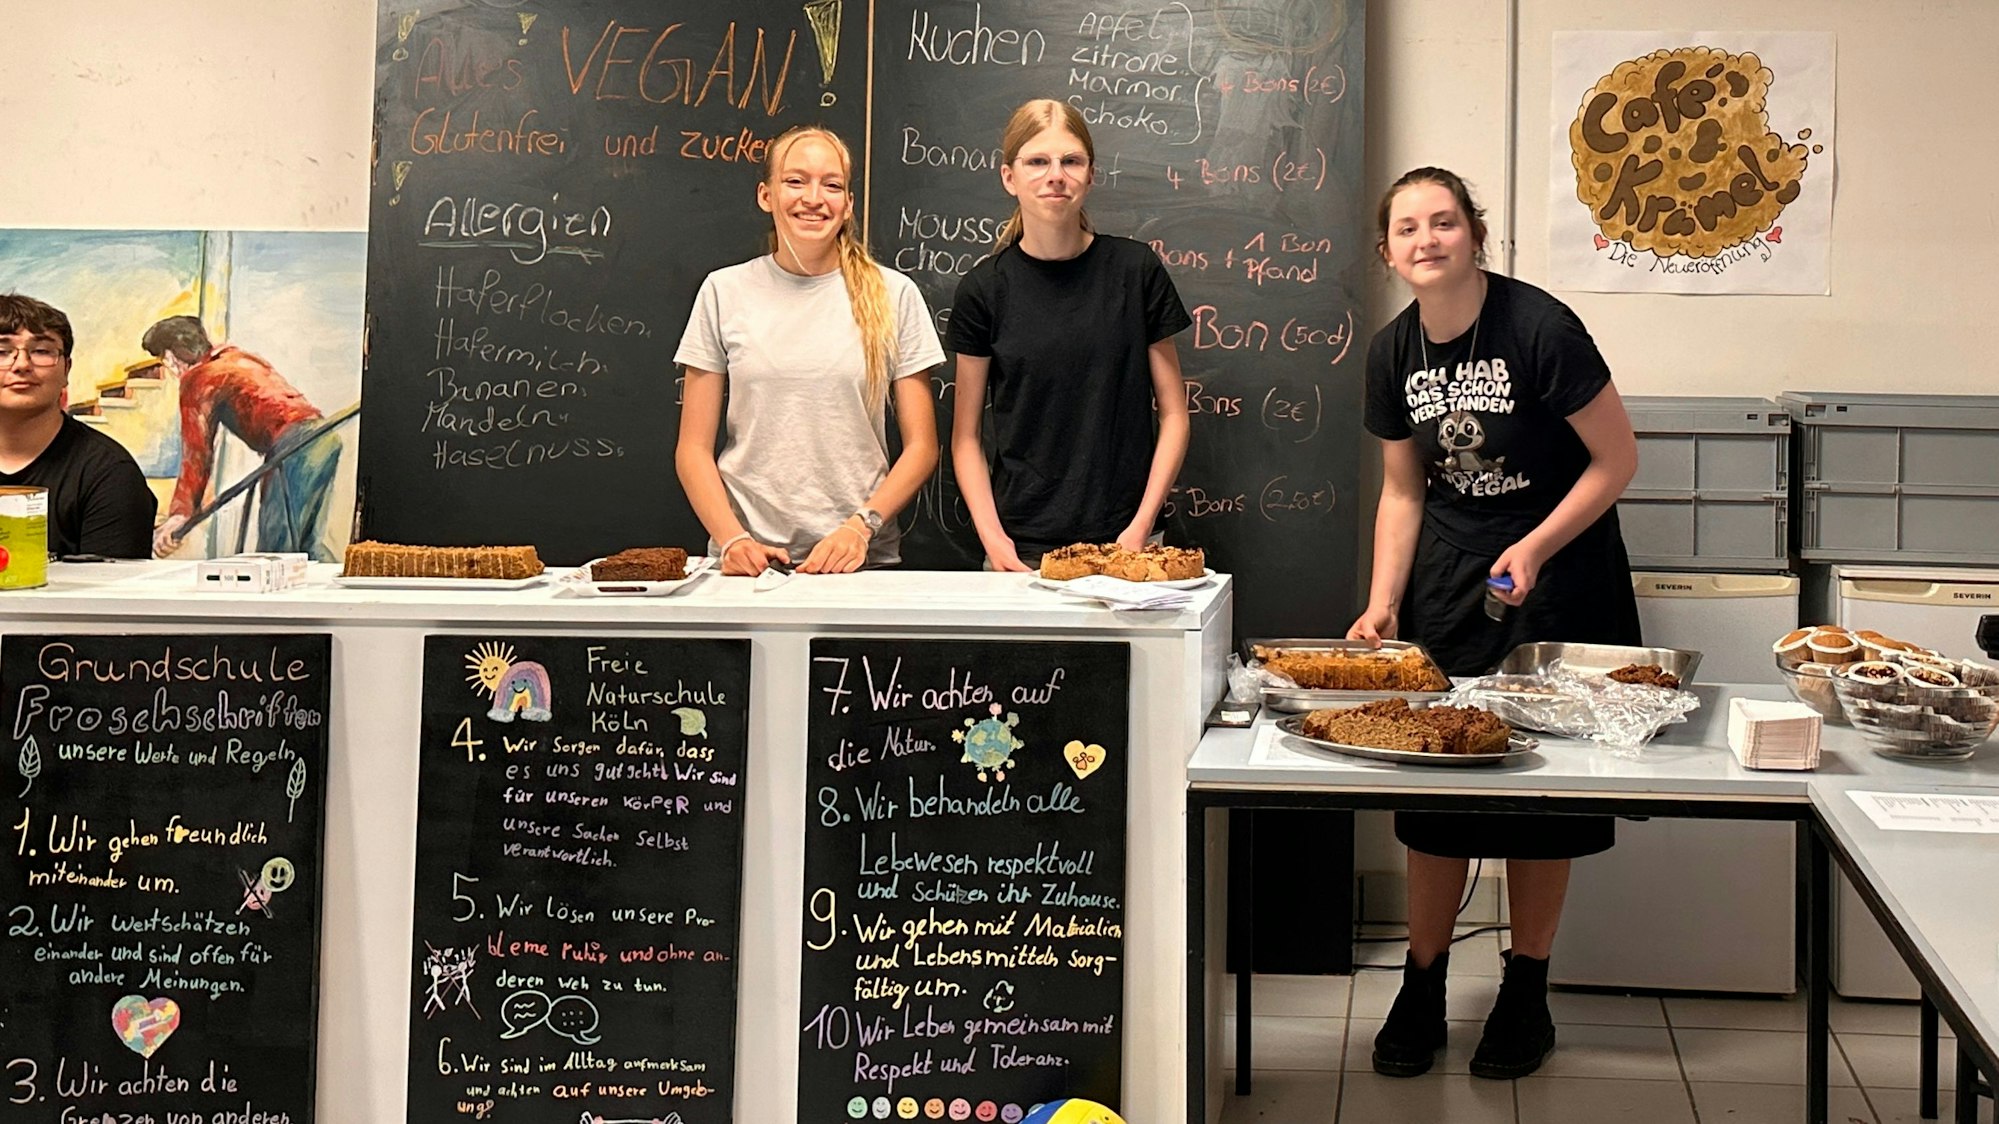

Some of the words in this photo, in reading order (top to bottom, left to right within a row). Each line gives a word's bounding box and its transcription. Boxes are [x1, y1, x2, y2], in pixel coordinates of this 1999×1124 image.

[907, 2, 1046, 65] Kuchen
[1079, 8, 1163, 42] Apfel
[562, 20, 796, 117] VEGAN
[1243, 70, 1300, 93] Bons
[1582, 60, 1724, 154] Café
[410, 107, 567, 157] Glutenfrei
[604, 125, 659, 158] und
[1167, 165, 1184, 190] 4
[1195, 158, 1261, 185] Bons
[424, 192, 612, 265] Allergien
[1244, 232, 1265, 251] 1
[1280, 233, 1331, 253] Bon
[1243, 257, 1317, 286] Pfand
[1608, 241, 1638, 268] Die
[1649, 236, 1772, 275] Neueröffnung
[1192, 304, 1269, 352] Bon
[1405, 367, 1448, 394] ICH
[1455, 358, 1510, 382] HAB
[1184, 380, 1242, 417] Bons
[1406, 386, 1444, 408] DAS
[1447, 380, 1512, 398] SCHON
[1409, 396, 1515, 425] VERSTANDEN
[1472, 472, 1530, 496] EGAL
[1186, 487, 1246, 518] Bons
[1655, 583, 1693, 591] SEVERIN
[1953, 592, 1992, 600] SEVERIN
[38, 642, 310, 683] Grundschule
[586, 645, 649, 675] Freie
[586, 679, 727, 707] Naturschule
[813, 656, 852, 716] 7.
[862, 655, 913, 712] Wir
[921, 667, 993, 710] achten
[1011, 667, 1065, 705] auf
[58, 743, 127, 763] unsere
[135, 741, 180, 765] Werte
[189, 746, 217, 765] und
[226, 738, 296, 773] Regeln
[451, 717, 487, 762] 4.
[503, 736, 538, 754] Wir
[676, 739, 715, 762] dass
[828, 738, 871, 771] die
[880, 726, 937, 761] Natur.
[505, 764, 530, 780] es
[546, 762, 580, 779] uns
[594, 762, 622, 782] gut
[673, 763, 706, 782] Wir
[503, 787, 534, 804] für
[545, 790, 609, 808] unseren
[704, 799, 732, 814] und
[818, 786, 851, 827] 8.
[855, 781, 899, 822] Wir
[908, 774, 1021, 819] behandeln
[1027, 781, 1086, 814] alle
[13, 807, 37, 856] 1.
[49, 814, 97, 854] Wir
[109, 819, 158, 863] gehen
[165, 815, 267, 845] freundlich
[503, 817, 561, 838] unsere
[572, 823, 620, 843] Sachen
[859, 832, 978, 876] Lebewesen
[988, 840, 1094, 879] respektvoll
[29, 860, 128, 889] miteinander
[137, 874, 180, 894] um.
[858, 876, 899, 899] und
[997, 881, 1032, 902] ihr
[1041, 881, 1121, 909] Zuhause.
[453, 872, 484, 922] 5.
[496, 893, 534, 918] Wir
[547, 896, 595, 924] lösen
[612, 906, 674, 925] unsere
[685, 908, 716, 926] Pro-
[8, 905, 44, 937] 2.
[50, 903, 94, 934] Wir
[806, 887, 847, 950] 9.
[853, 912, 896, 944] Wir
[902, 907, 968, 950] gehen
[974, 910, 1017, 936] mit
[34, 942, 103, 962] einander
[111, 941, 142, 961] und
[149, 943, 182, 964] sind
[189, 945, 235, 966] offen
[241, 941, 272, 964] für
[488, 930, 550, 957] bleme
[620, 947, 653, 963] und
[657, 944, 695, 963] ohne
[703, 950, 730, 963] an-
[855, 944, 900, 970] und
[913, 939, 1059, 968] Lebensmitteln
[69, 962, 125, 986] andere
[139, 967, 245, 1000] Meinungen.
[496, 969, 544, 988] deren
[602, 979, 623, 991] zu
[634, 976, 667, 993] tun.
[854, 977, 910, 1010] fältig
[915, 979, 968, 997] um.
[803, 1004, 851, 1050] 10
[855, 1011, 896, 1048] Wir
[964, 1016, 1079, 1045] gemeinsam
[1082, 1014, 1114, 1035] mit
[438, 1036, 459, 1075] 6.
[460, 1053, 491, 1074] Wir
[501, 1059, 530, 1075] sind
[539, 1057, 556, 1072] im
[563, 1051, 618, 1072] Alltag
[854, 1049, 933, 1095] Respekt
[940, 1047, 976, 1075] und
[990, 1044, 1070, 1069] Toleranz.
[5, 1058, 45, 1104] 3.
[56, 1056, 109, 1098] Wir
[118, 1059, 189, 1096] achten
[200, 1059, 238, 1093] die
[466, 1084, 490, 1097] und
[498, 1081, 541, 1100] achten
[552, 1081, 592, 1099] auf
[598, 1083, 647, 1097] unsere
[657, 1080, 716, 1097] Umgeb-
